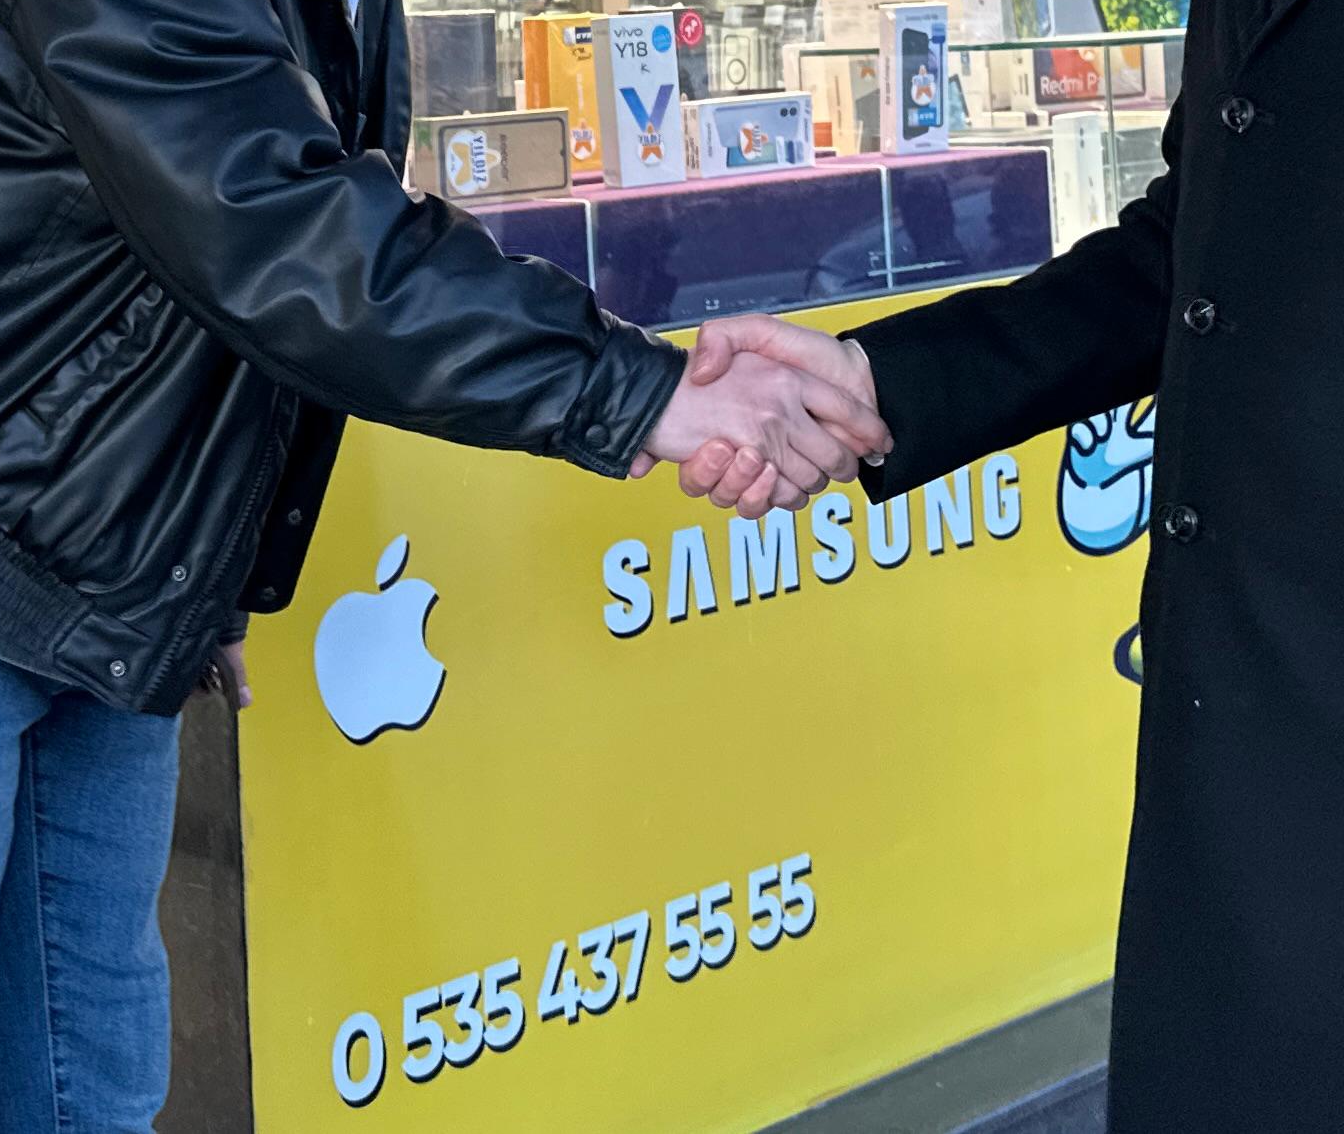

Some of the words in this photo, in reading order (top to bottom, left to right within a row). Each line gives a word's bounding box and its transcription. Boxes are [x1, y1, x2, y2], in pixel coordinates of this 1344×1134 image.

[613, 27, 644, 38] vivo
[616, 41, 648, 59] Y18
[1040, 73, 1084, 97] Redmi
[471, 134, 487, 183] YILDIZ
[602, 454, 1023, 640] SAMSUNG
[401, 957, 526, 1083] 535
[537, 909, 652, 1025] 437
[664, 880, 737, 983] 55
[748, 852, 817, 951] 55
